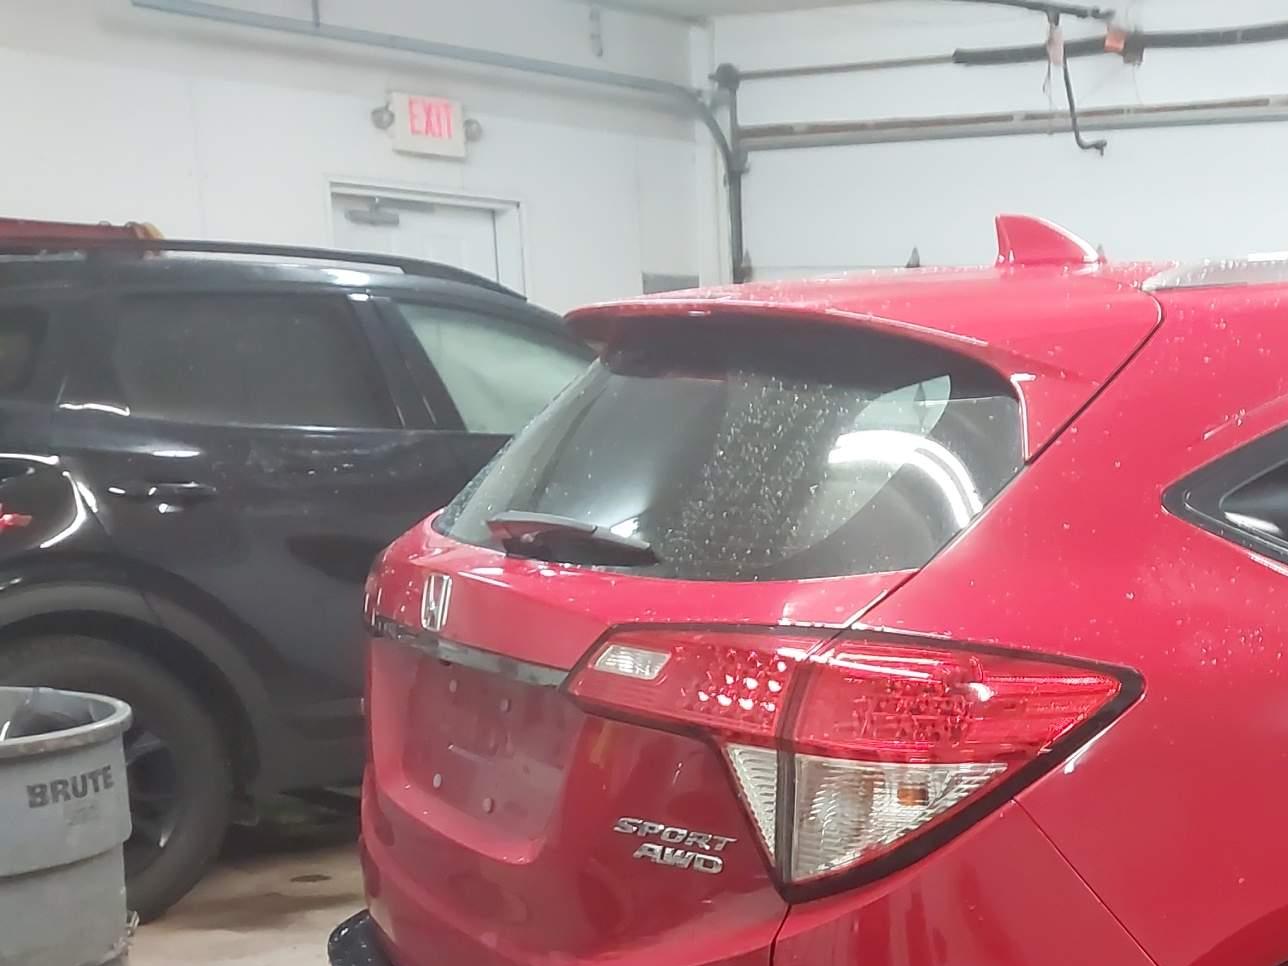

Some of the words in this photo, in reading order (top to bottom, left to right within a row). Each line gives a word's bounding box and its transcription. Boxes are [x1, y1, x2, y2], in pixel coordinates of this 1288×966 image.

[408, 97, 453, 139] EXIT
[26, 764, 114, 808] BRUTE
[613, 817, 737, 851] SPORT
[633, 843, 723, 874] AWD
